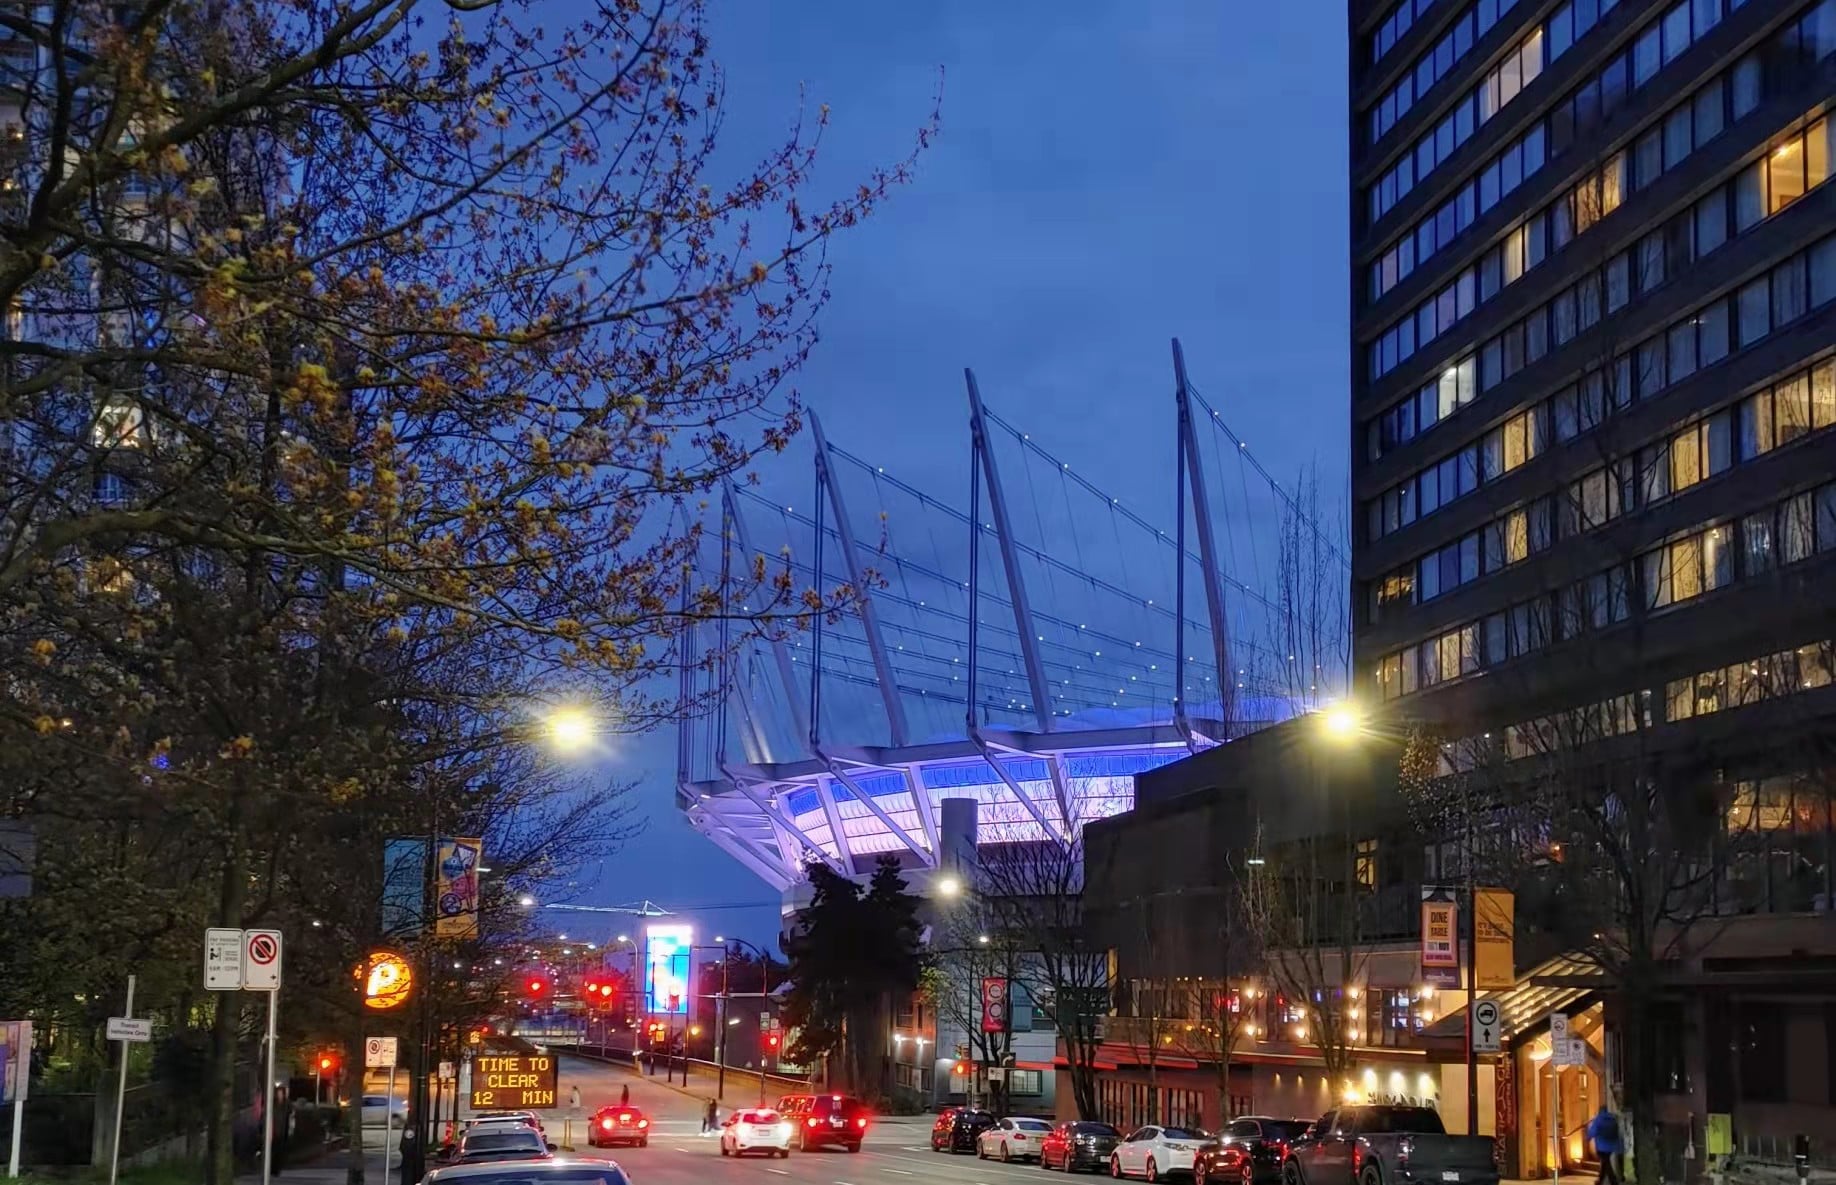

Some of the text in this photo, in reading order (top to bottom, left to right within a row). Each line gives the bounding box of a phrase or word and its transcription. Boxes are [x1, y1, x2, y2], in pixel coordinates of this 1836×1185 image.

[1430, 911, 1448, 924] DINE
[1430, 927, 1449, 937] TABLE
[478, 1057, 549, 1072] TIME TO
[487, 1074, 539, 1088] CLEAR
[473, 1090, 553, 1105] 12 MIN
